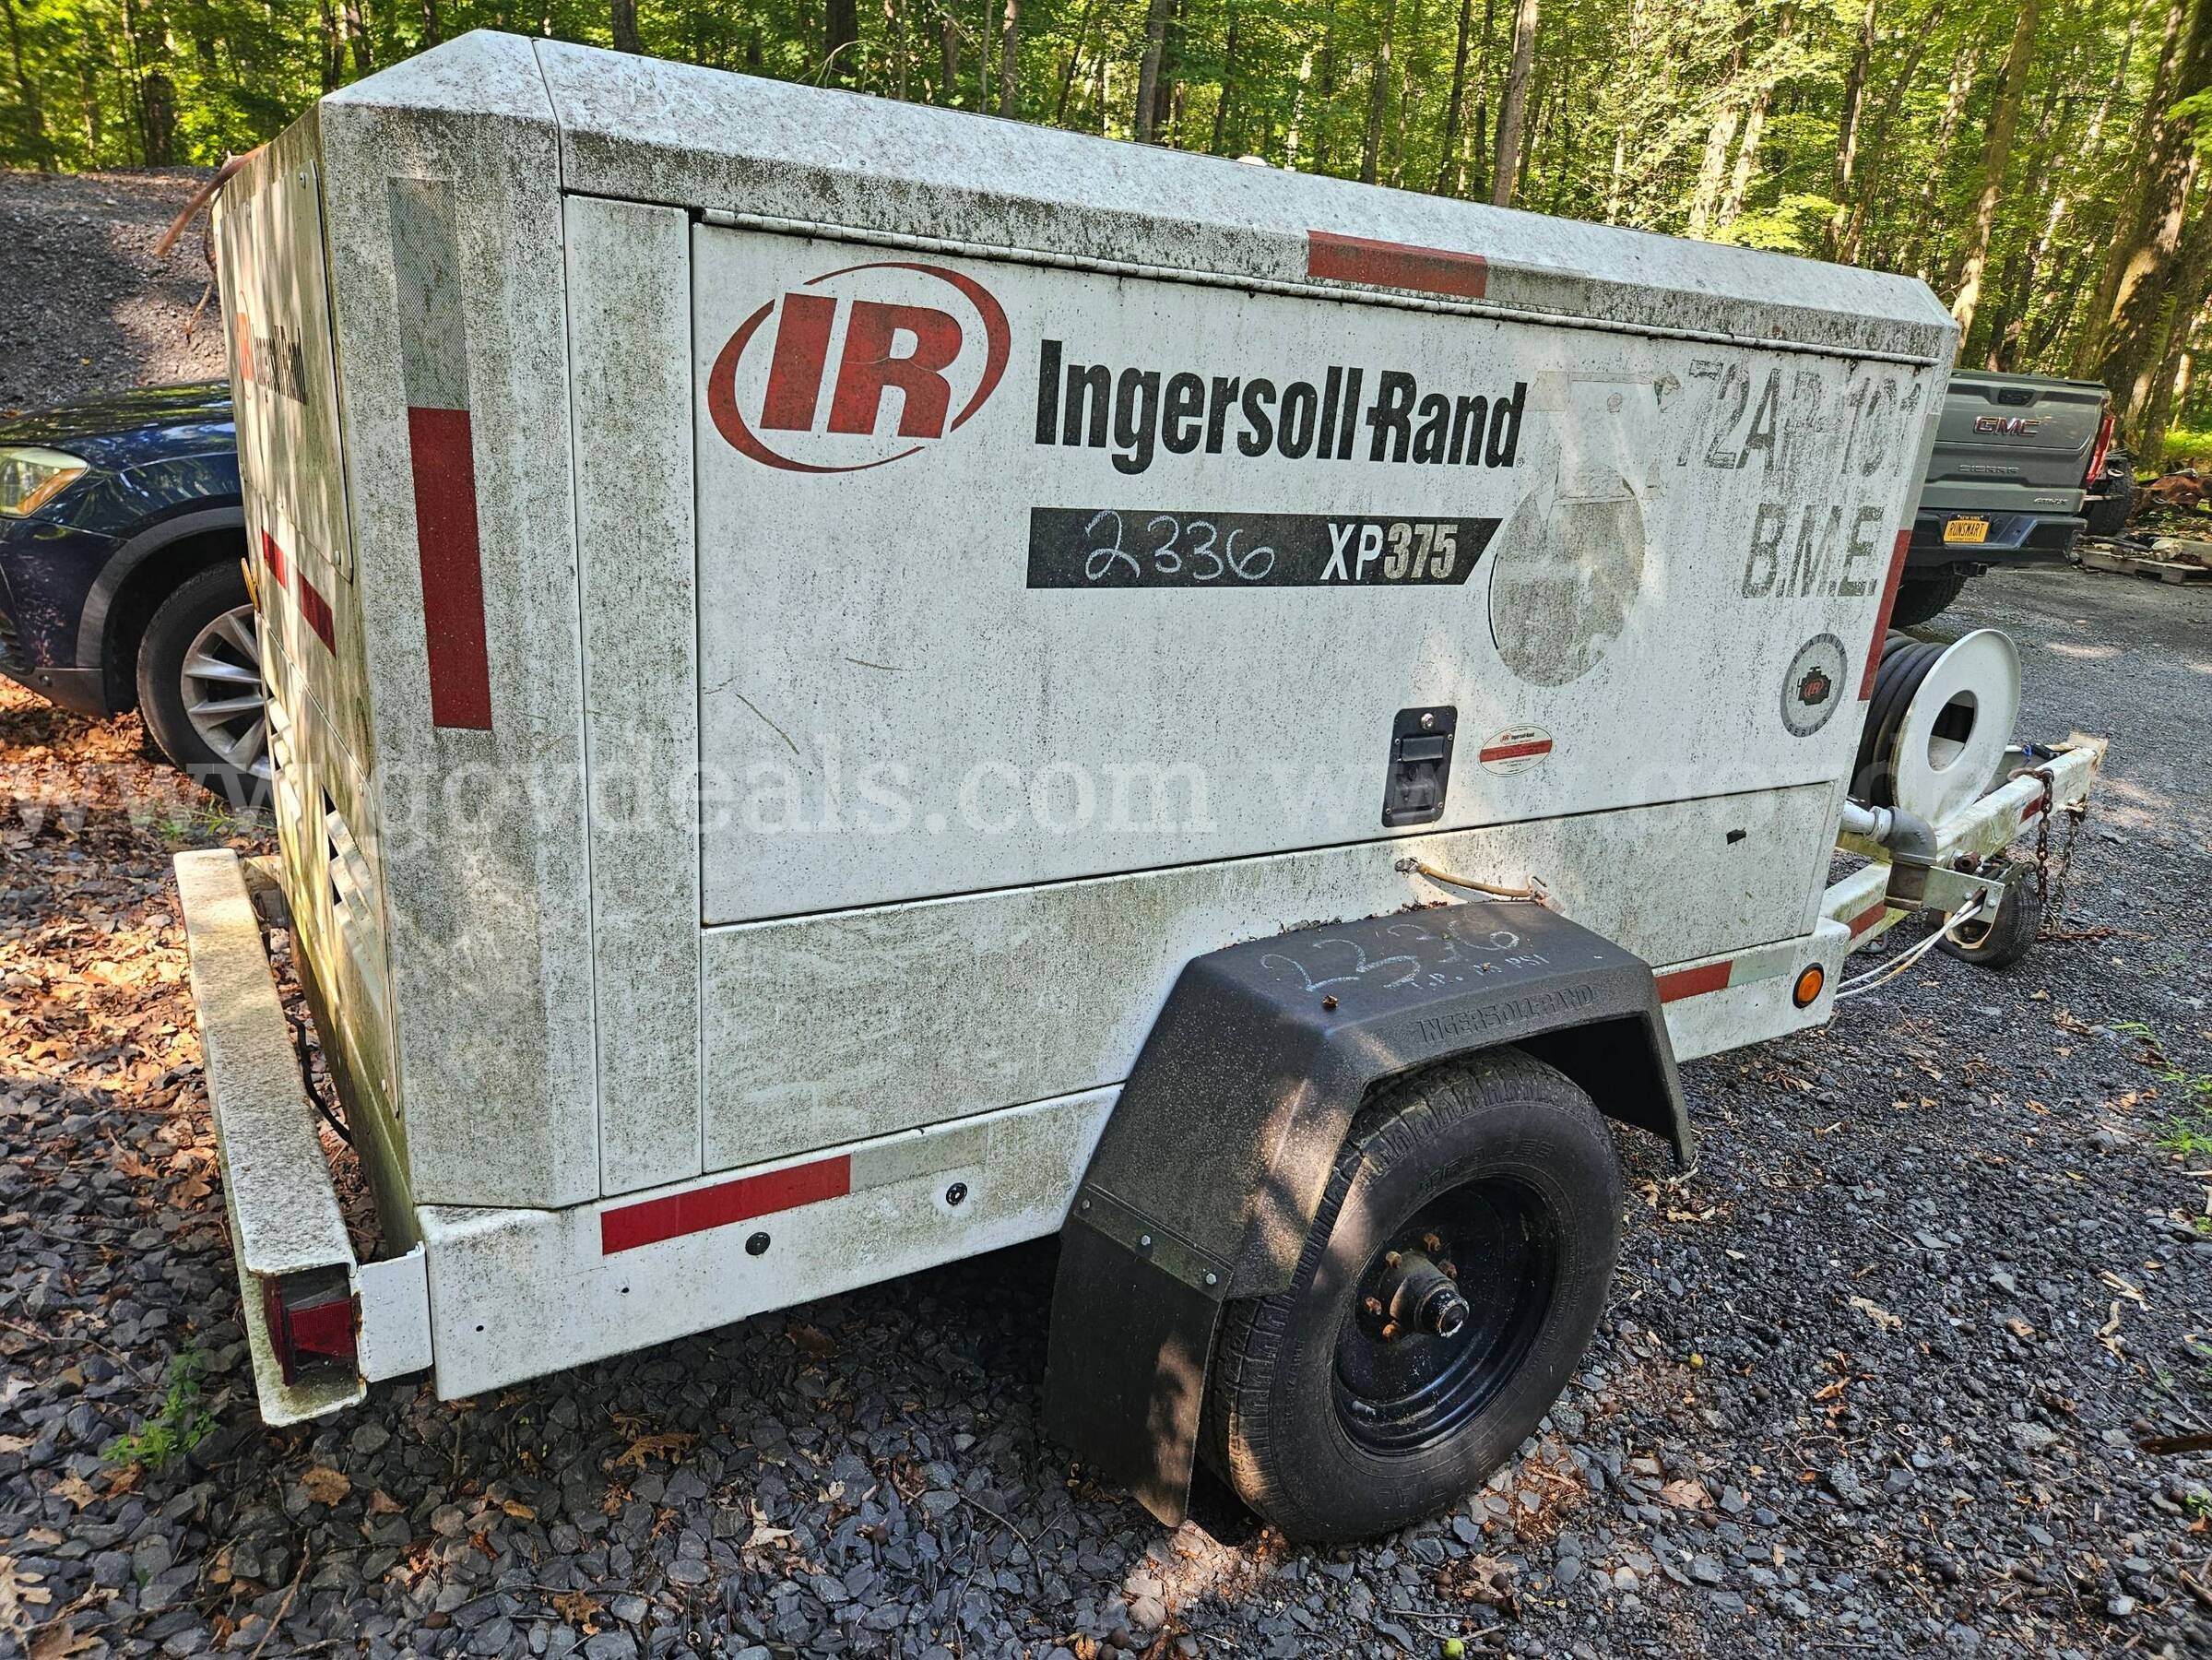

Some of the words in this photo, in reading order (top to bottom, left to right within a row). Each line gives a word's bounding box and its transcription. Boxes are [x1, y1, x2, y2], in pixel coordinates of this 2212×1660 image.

[761, 292, 963, 438] IR
[1035, 339, 1528, 474] Ingersoll-Rand
[1973, 415, 2041, 437] GMC
[1958, 463, 2020, 475] SIERRA
[1084, 509, 1276, 581] 2336
[1947, 522, 1985, 538] RUNSMART
[1319, 522, 1459, 581] XP375
[1788, 716, 1828, 737] SERIES
